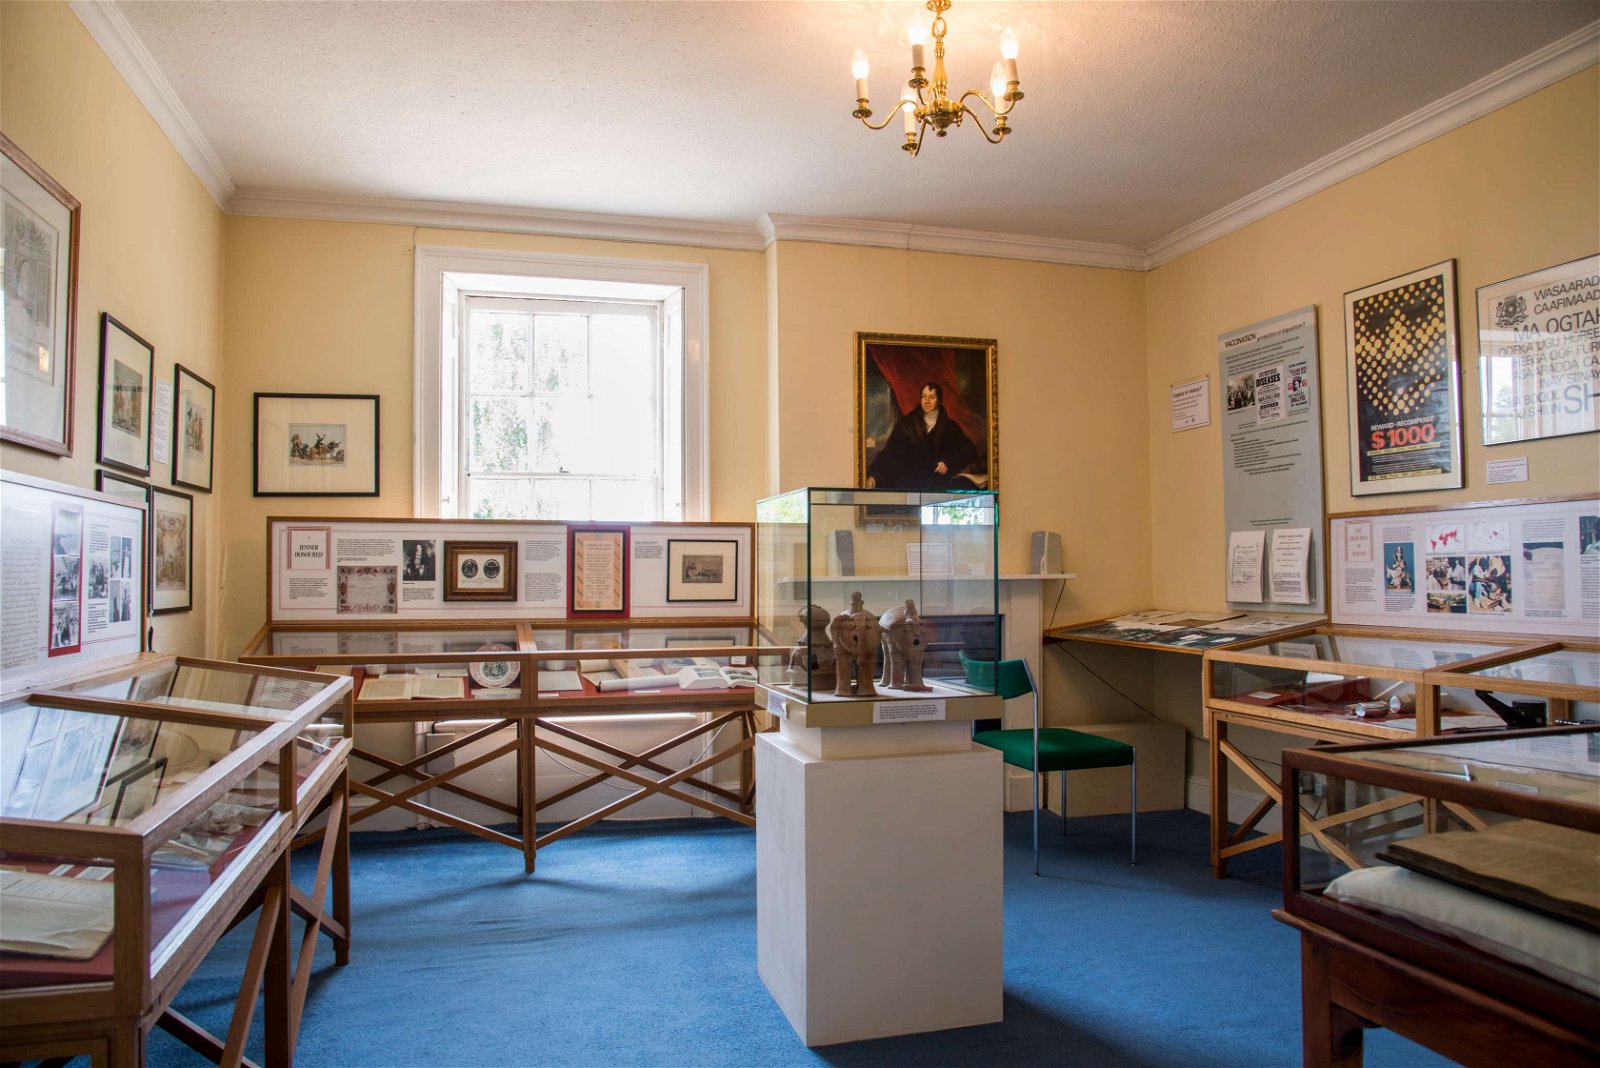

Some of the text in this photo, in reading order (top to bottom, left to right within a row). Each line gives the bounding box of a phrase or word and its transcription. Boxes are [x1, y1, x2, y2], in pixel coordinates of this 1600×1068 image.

[1514, 323, 1540, 343] MA
[1576, 341, 1600, 356] FUR
[1256, 373, 1280, 387] DISEASES
[1370, 422, 1395, 431] REWARD
